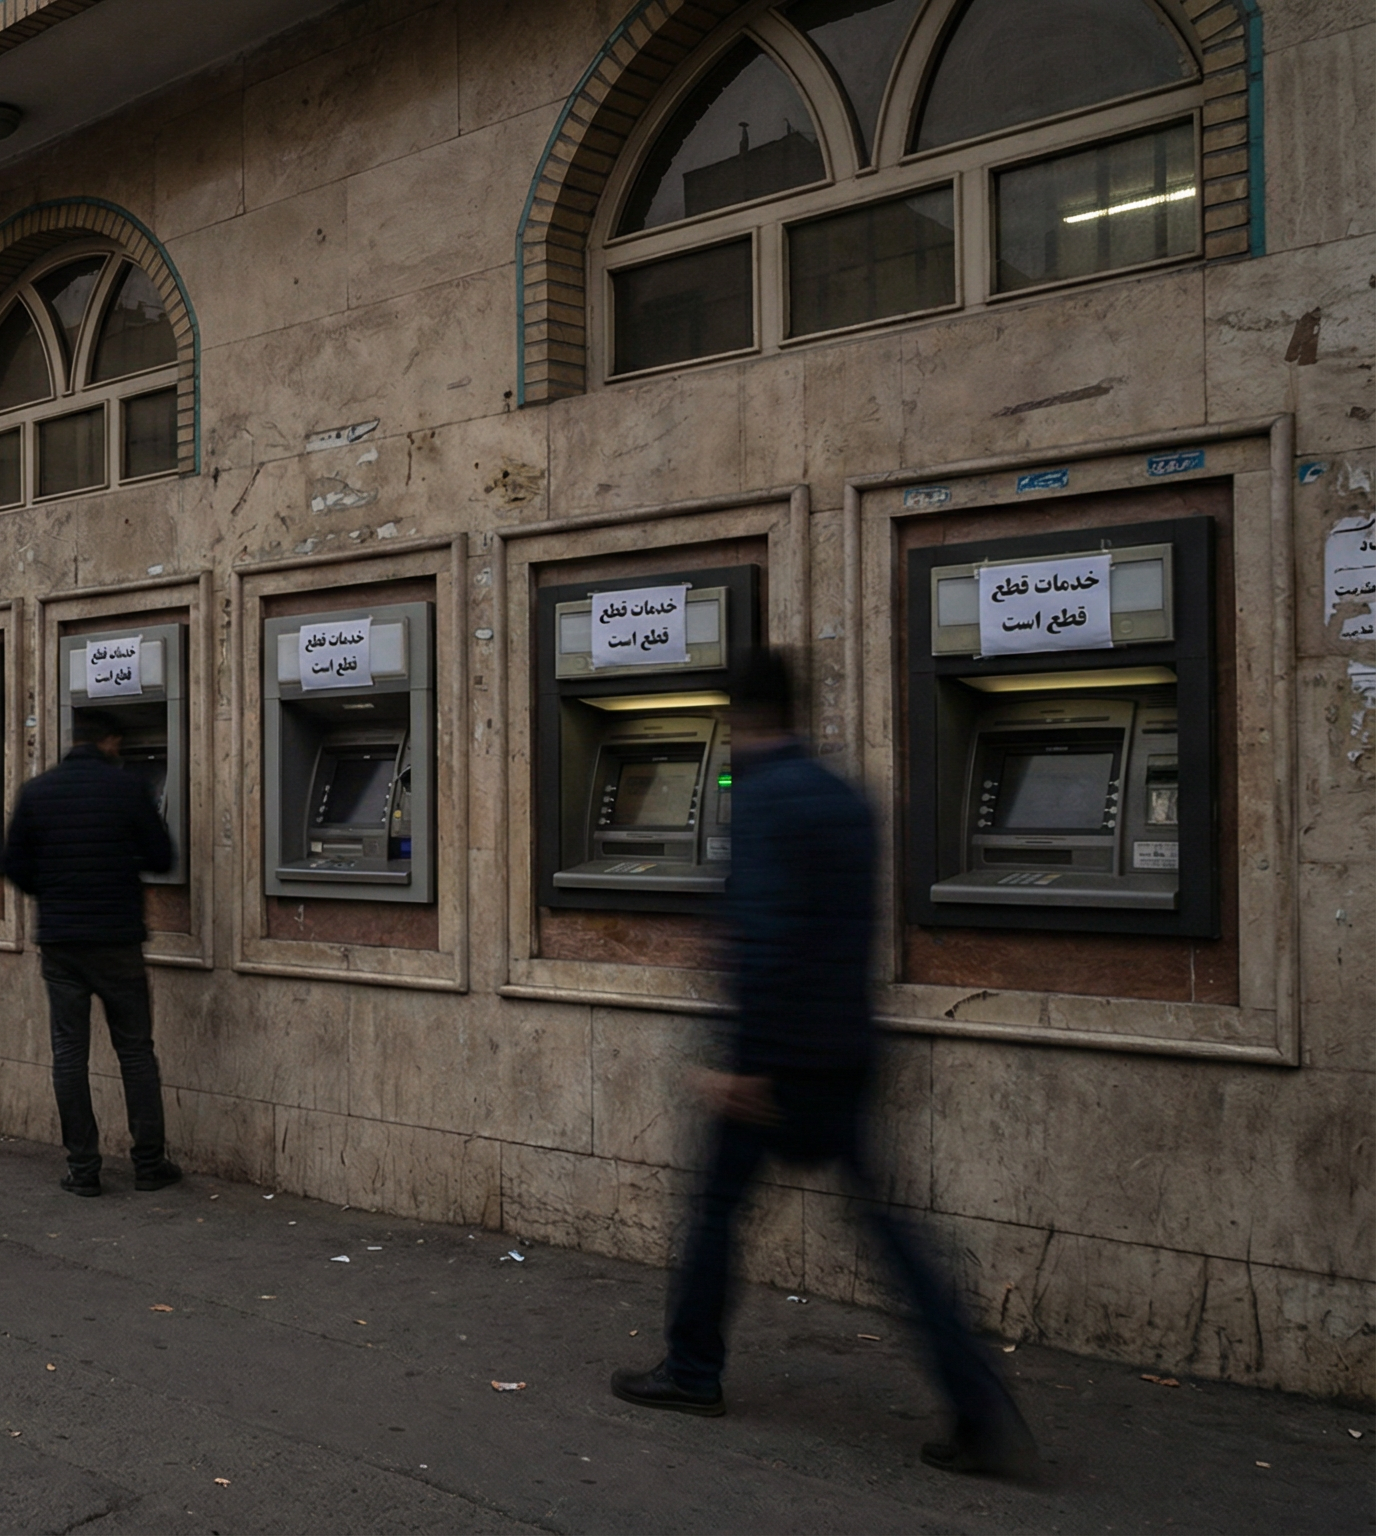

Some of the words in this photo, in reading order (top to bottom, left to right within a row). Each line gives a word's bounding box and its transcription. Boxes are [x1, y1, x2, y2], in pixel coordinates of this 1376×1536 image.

[991, 575, 1029, 603] قطع
[1034, 570, 1100, 594] خدمات
[599, 600, 628, 624] قطع
[630, 598, 677, 616] خدمات
[1002, 611, 1041, 632] است
[1046, 606, 1087, 634] قطع
[305, 632, 326, 653] قطع
[328, 630, 365, 646] خدمات
[608, 631, 636, 648] است
[640, 626, 669, 651] قطع
[312, 658, 334, 674] است
[336, 655, 357, 676] قطع
